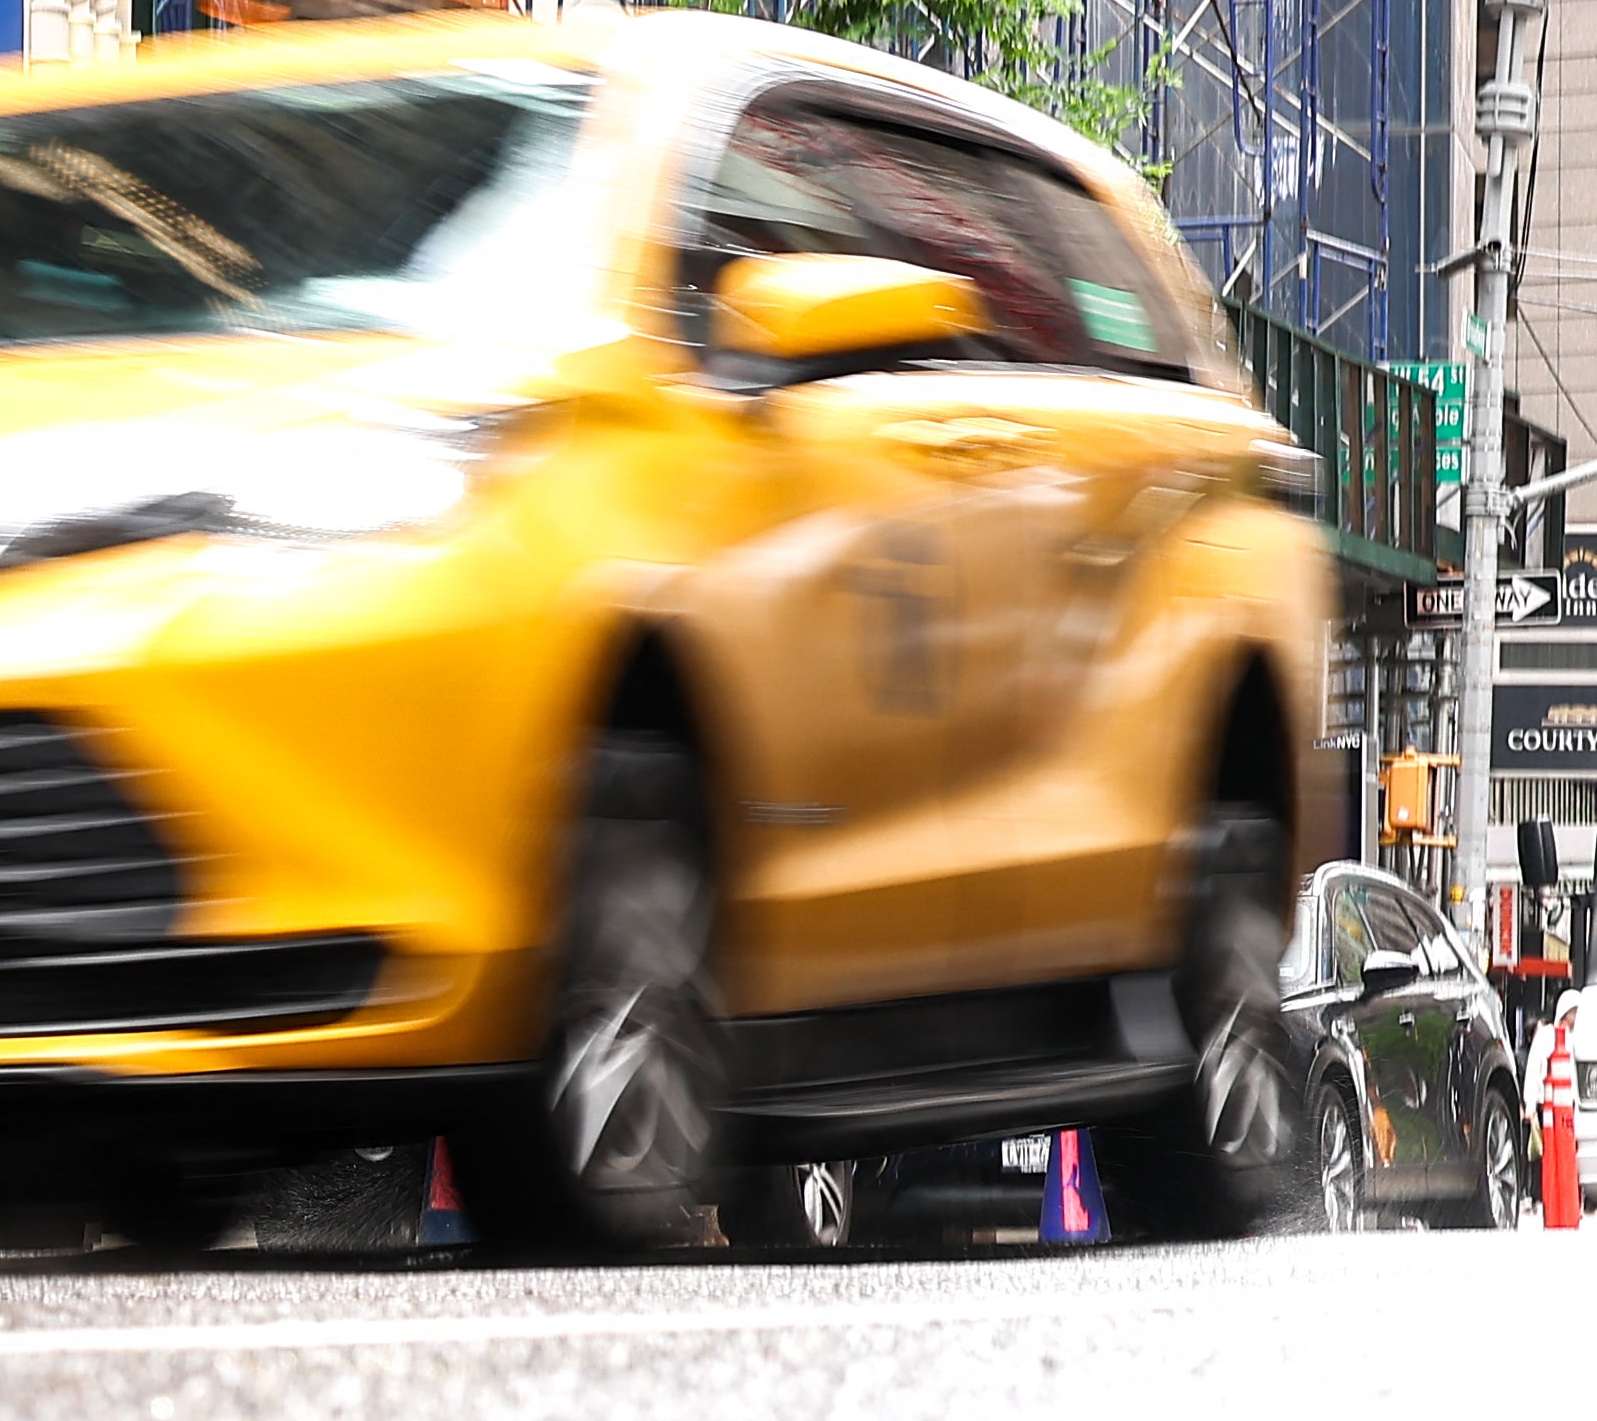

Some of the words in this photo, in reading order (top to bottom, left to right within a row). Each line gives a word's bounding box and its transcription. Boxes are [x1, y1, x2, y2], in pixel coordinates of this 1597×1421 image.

[1422, 590, 1459, 613] ONE
[1496, 585, 1533, 611] WAY
[1507, 728, 1597, 752] COURTY
